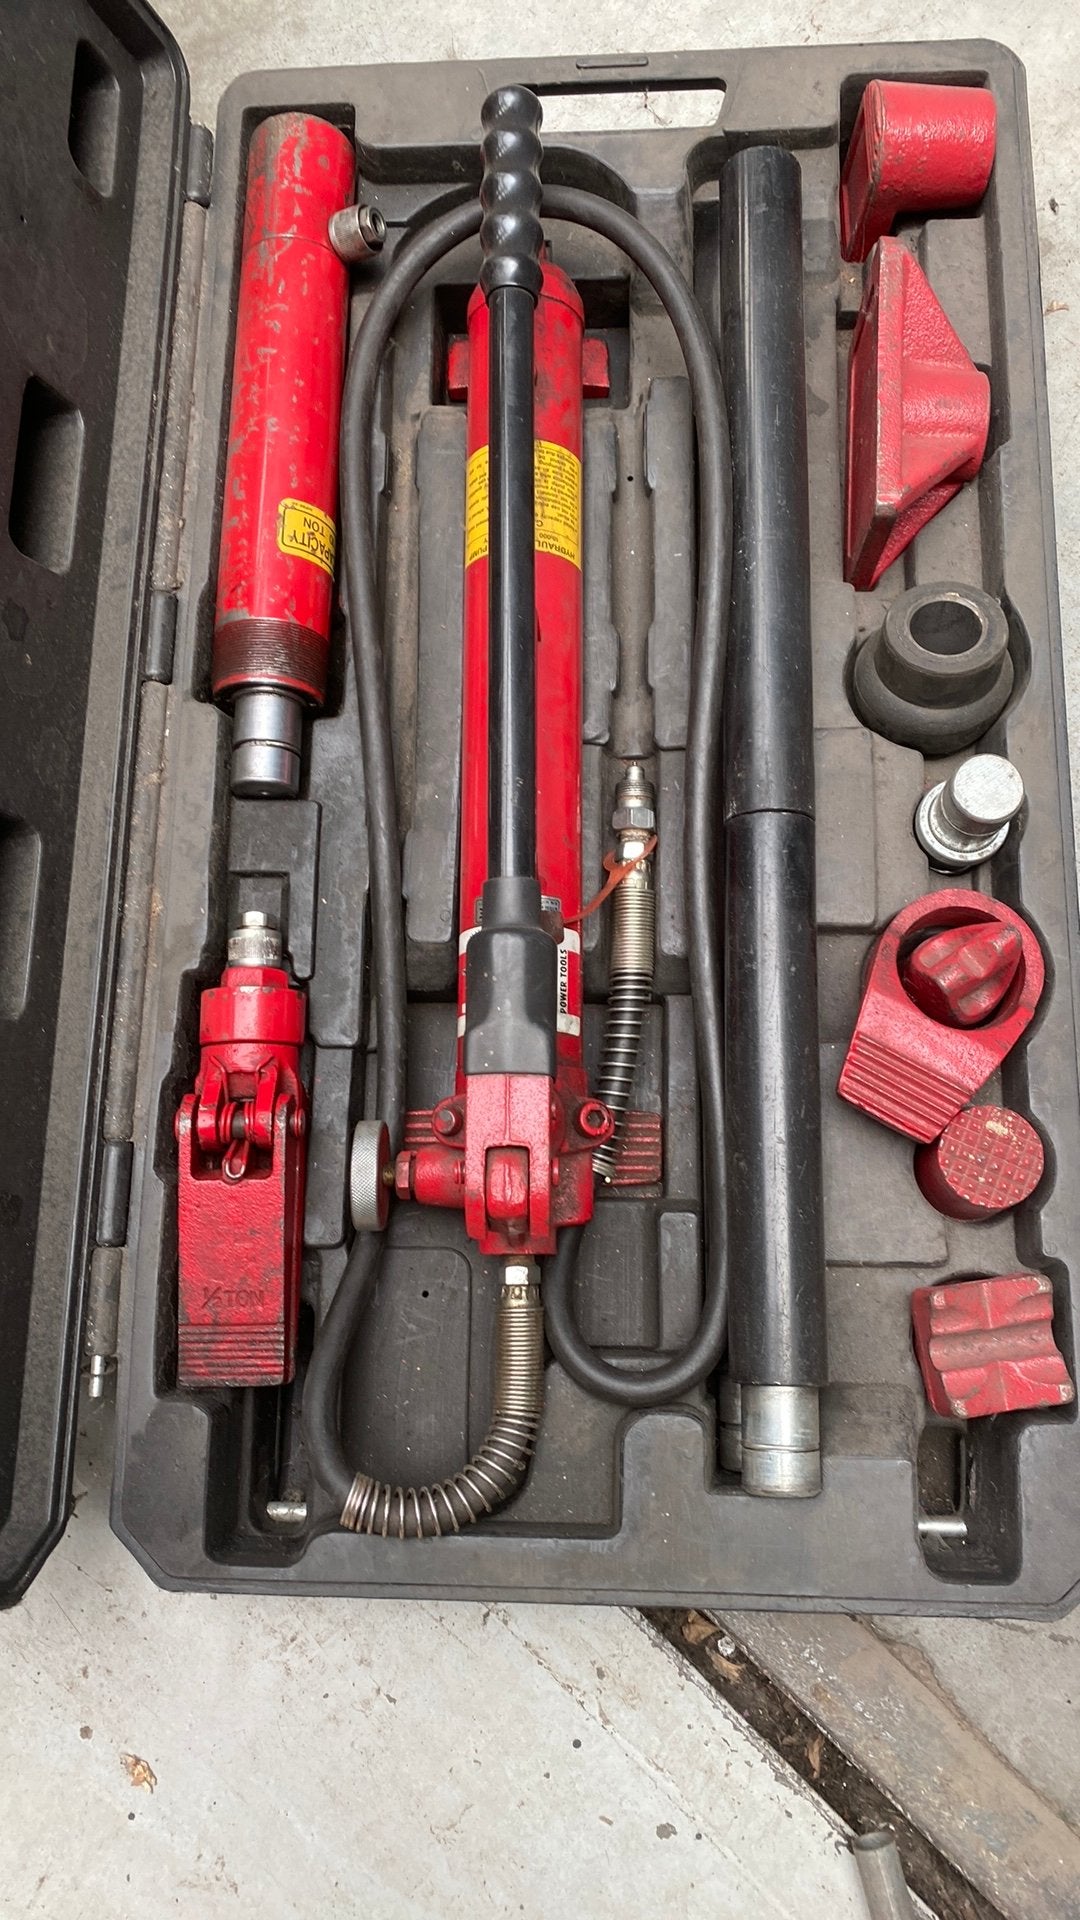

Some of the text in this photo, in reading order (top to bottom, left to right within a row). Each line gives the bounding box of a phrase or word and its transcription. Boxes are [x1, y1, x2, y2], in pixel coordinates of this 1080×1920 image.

[304, 517, 325, 537] TON
[535, 540, 577, 560] HYDRAUL
[560, 948, 568, 979] TOOLS
